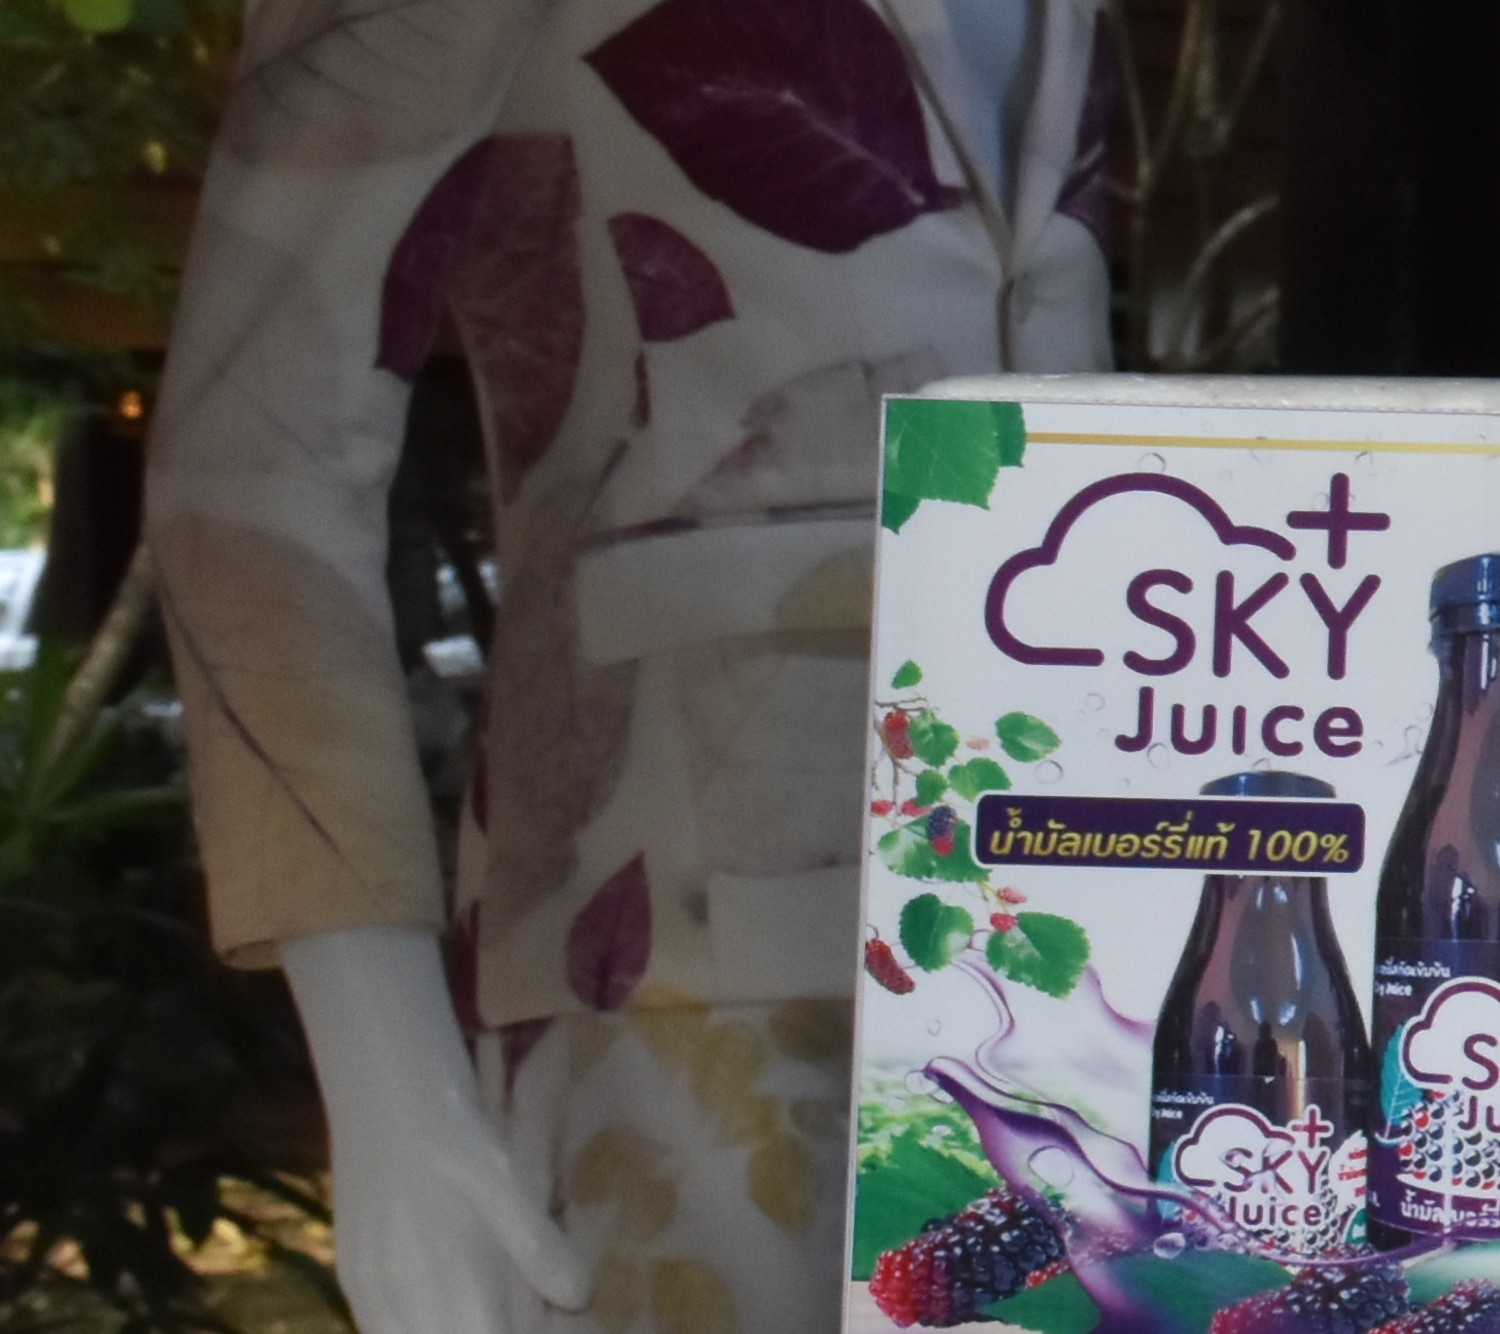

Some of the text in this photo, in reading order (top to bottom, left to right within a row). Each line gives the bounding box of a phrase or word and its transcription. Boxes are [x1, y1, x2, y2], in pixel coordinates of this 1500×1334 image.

[1114, 685, 1365, 759] Juice
[989, 806, 1350, 864] น้ำมัลเบอร์รี่แท้ 100%
